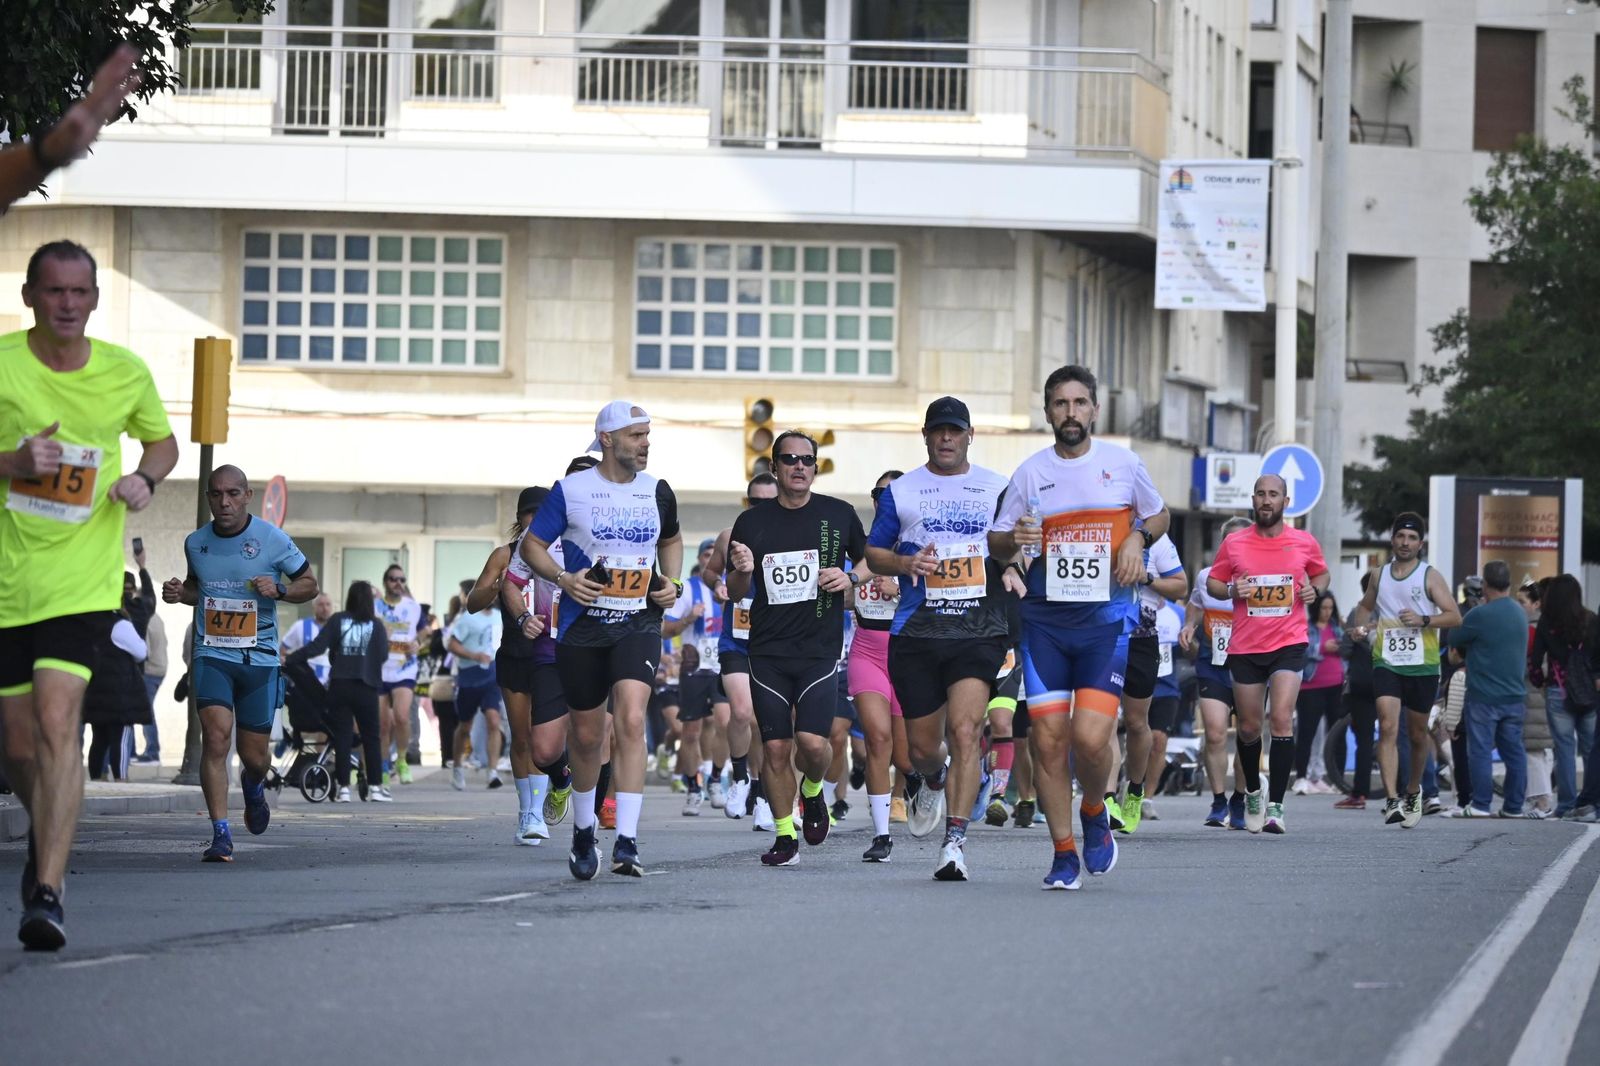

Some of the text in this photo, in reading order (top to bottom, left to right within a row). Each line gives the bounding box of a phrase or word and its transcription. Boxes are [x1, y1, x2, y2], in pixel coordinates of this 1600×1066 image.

[28, 497, 66, 515] Huelva
[592, 507, 657, 517] RUNNERS
[920, 500, 988, 512] RUNNERS
[820, 520, 828, 552] PUERTA
[833, 529, 840, 539] IV
[830, 540, 839, 567] DUATL
[820, 554, 828, 569] DEL
[934, 558, 973, 579] 451
[1057, 558, 1100, 579] 855
[772, 564, 810, 585] 650
[780, 590, 803, 599] Huelva
[1253, 586, 1286, 601] 473
[604, 598, 632, 606] Huelva
[211, 612, 248, 630] 477
[216, 636, 240, 644] Huelva
[1388, 638, 1417, 651] 835
